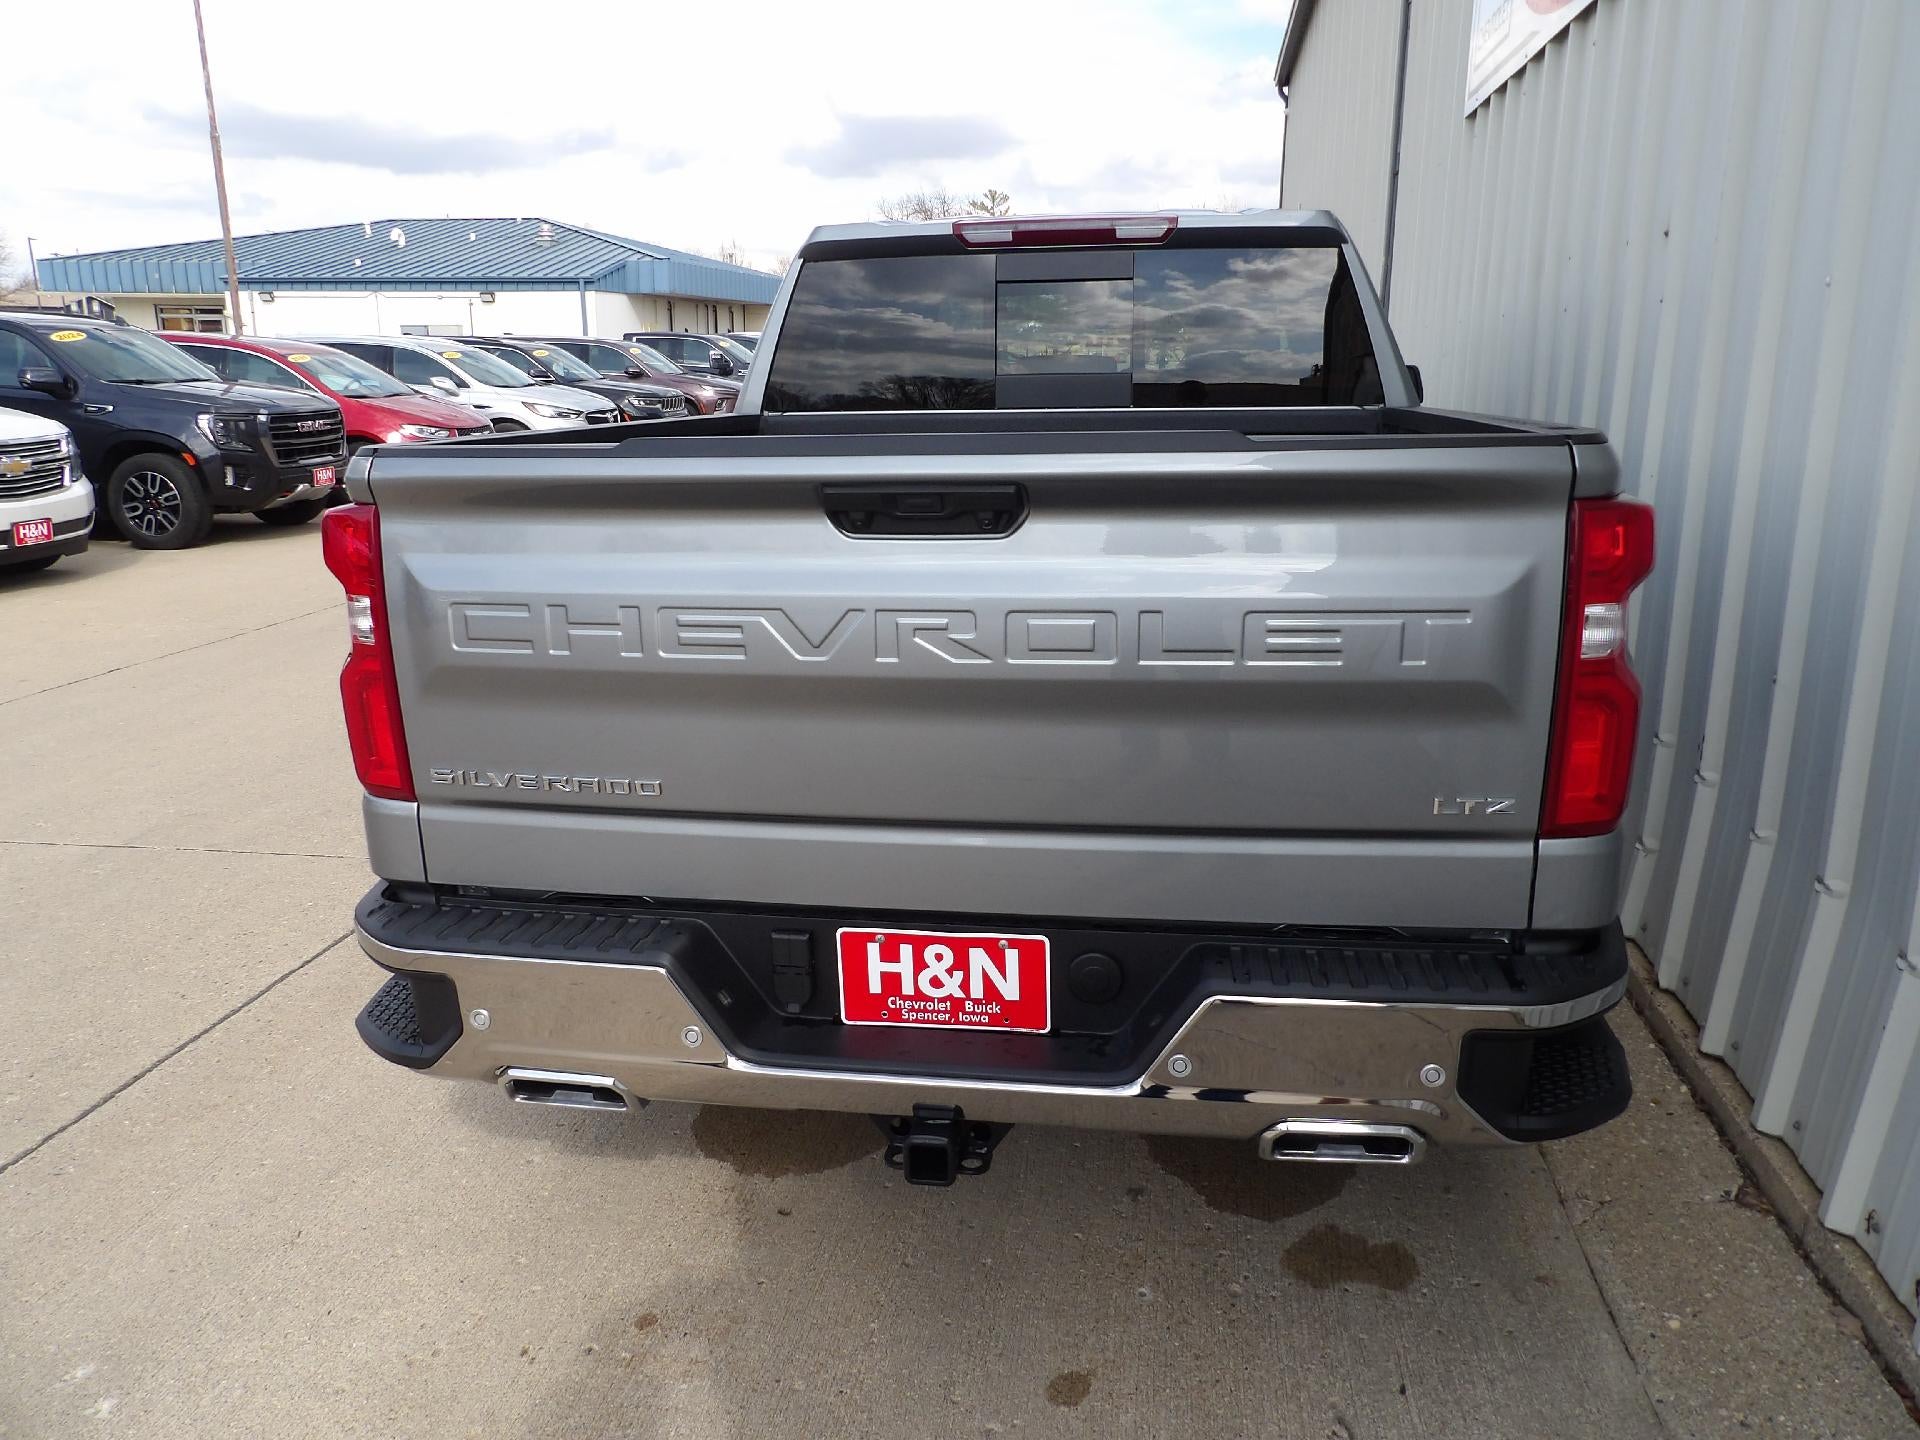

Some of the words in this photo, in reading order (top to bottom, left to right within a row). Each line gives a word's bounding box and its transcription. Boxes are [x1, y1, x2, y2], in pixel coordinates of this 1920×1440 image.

[316, 468, 333, 481] H&N
[19, 522, 49, 539] H&N
[449, 602, 1473, 666] CHEVROLET
[430, 768, 662, 796] SILVERADO
[1433, 797, 1516, 815] LTZ
[866, 942, 1020, 1001] H&N
[887, 996, 951, 1012] Chevrolet
[965, 1000, 1001, 1014] Buick
[901, 1008, 956, 1024] Spencer,
[958, 1011, 989, 1024] Iowa
